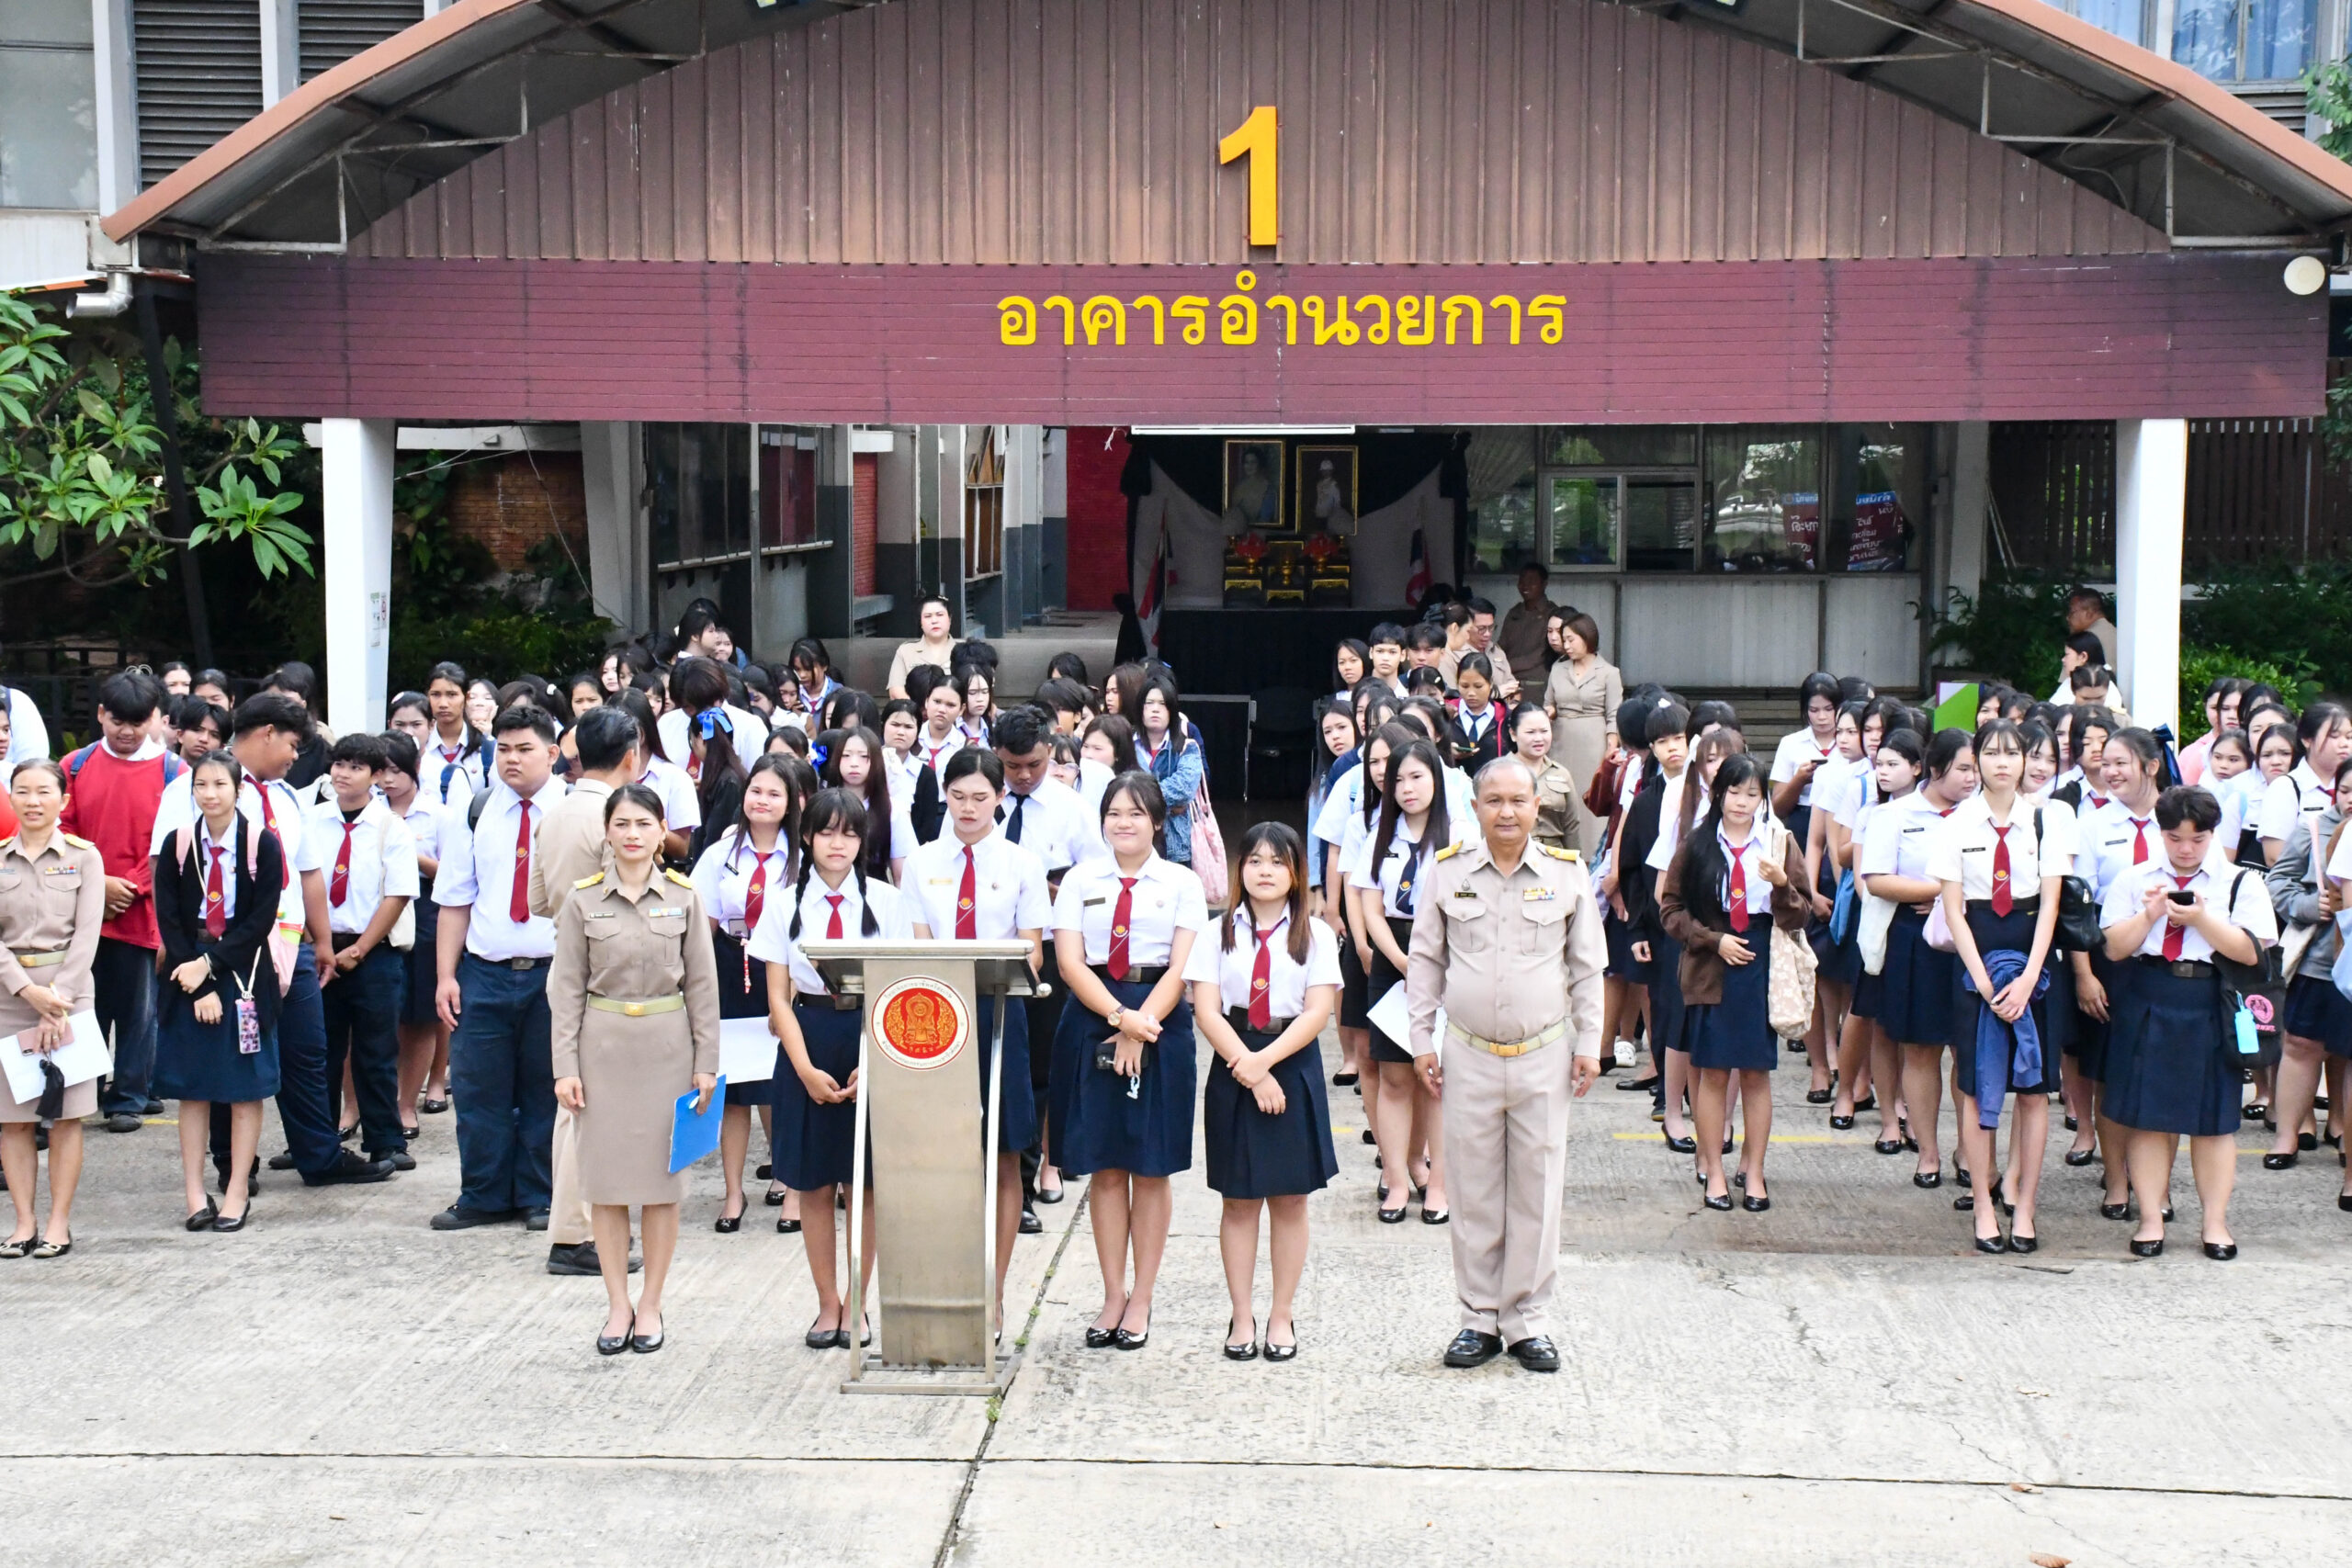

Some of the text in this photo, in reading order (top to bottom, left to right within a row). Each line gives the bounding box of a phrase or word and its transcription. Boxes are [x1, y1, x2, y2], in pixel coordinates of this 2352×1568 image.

[1219, 106, 1277, 245] 1
[997, 270, 1567, 345] อาคารอำนวยการ
